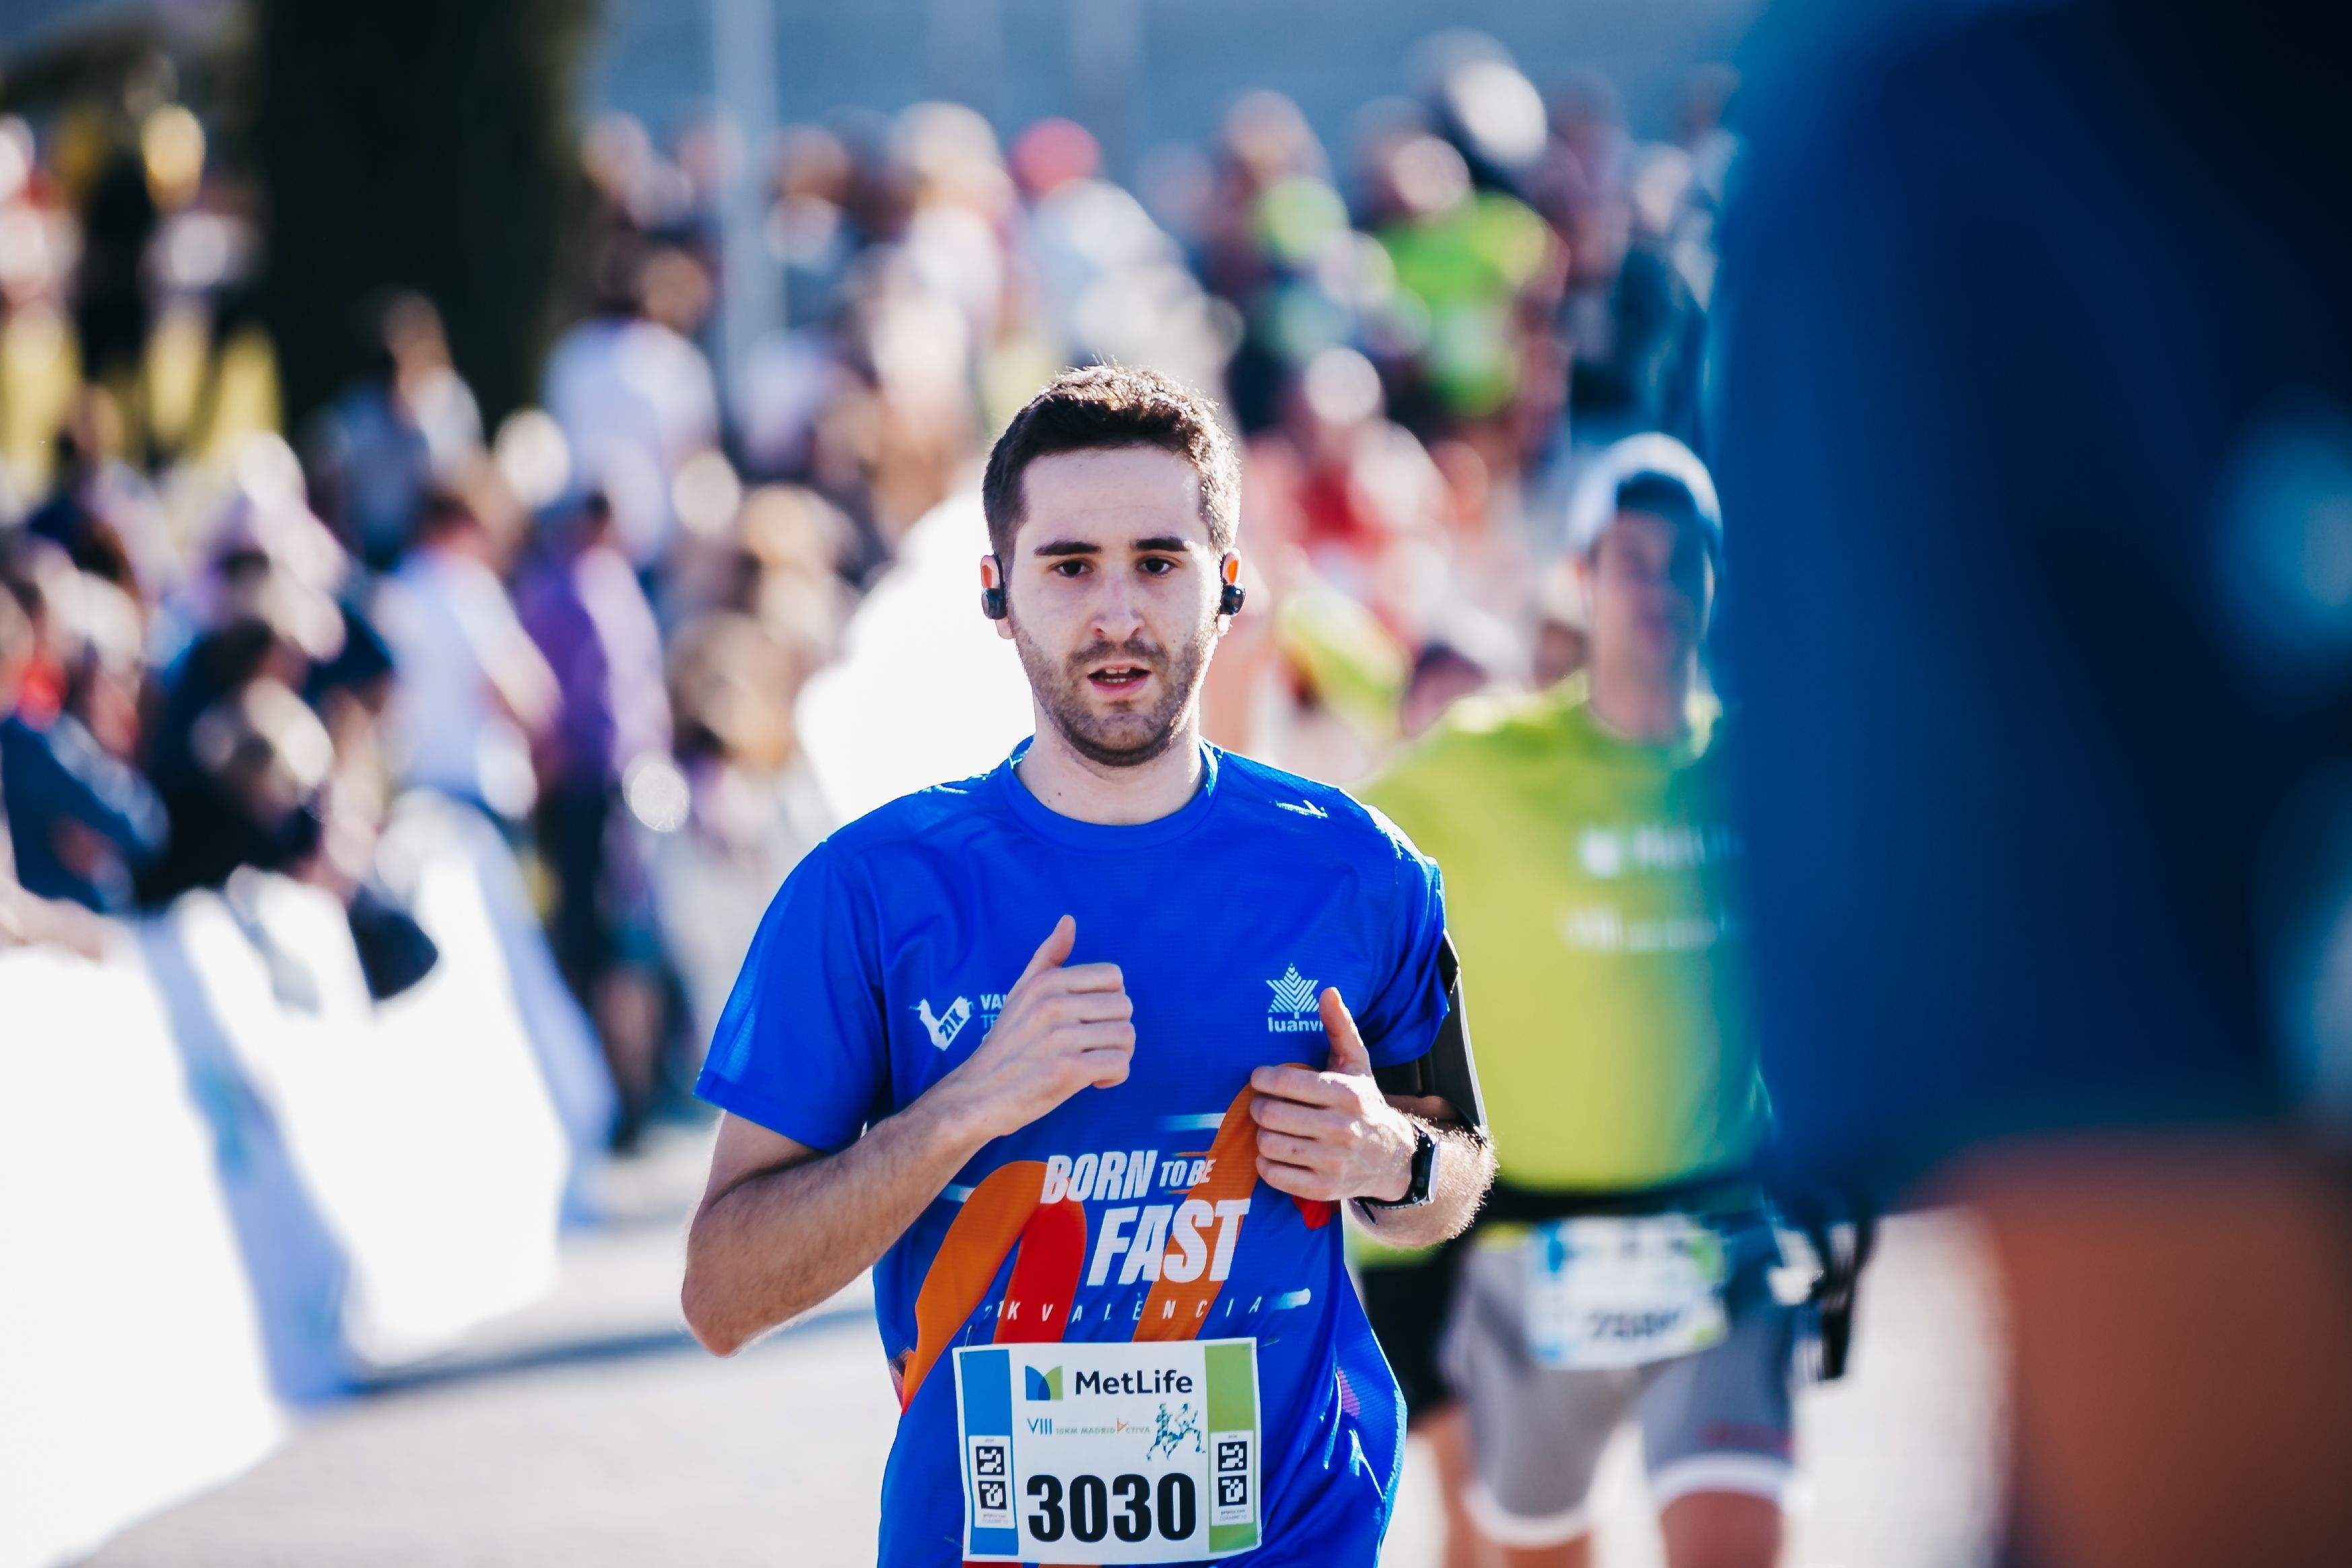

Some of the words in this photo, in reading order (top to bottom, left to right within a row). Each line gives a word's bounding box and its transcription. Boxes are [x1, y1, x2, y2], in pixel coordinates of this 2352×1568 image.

[938, 1009, 964, 1040] 21K
[1040, 1150, 1158, 1204] BORN
[1159, 1161, 1187, 1188] TO
[1186, 1159, 1216, 1186] BE
[1086, 1198, 1251, 1287] FAST
[1076, 1369, 1193, 1395] MetLife
[1026, 1418, 1052, 1435] VIII
[1026, 1472, 1197, 1542] 3030
